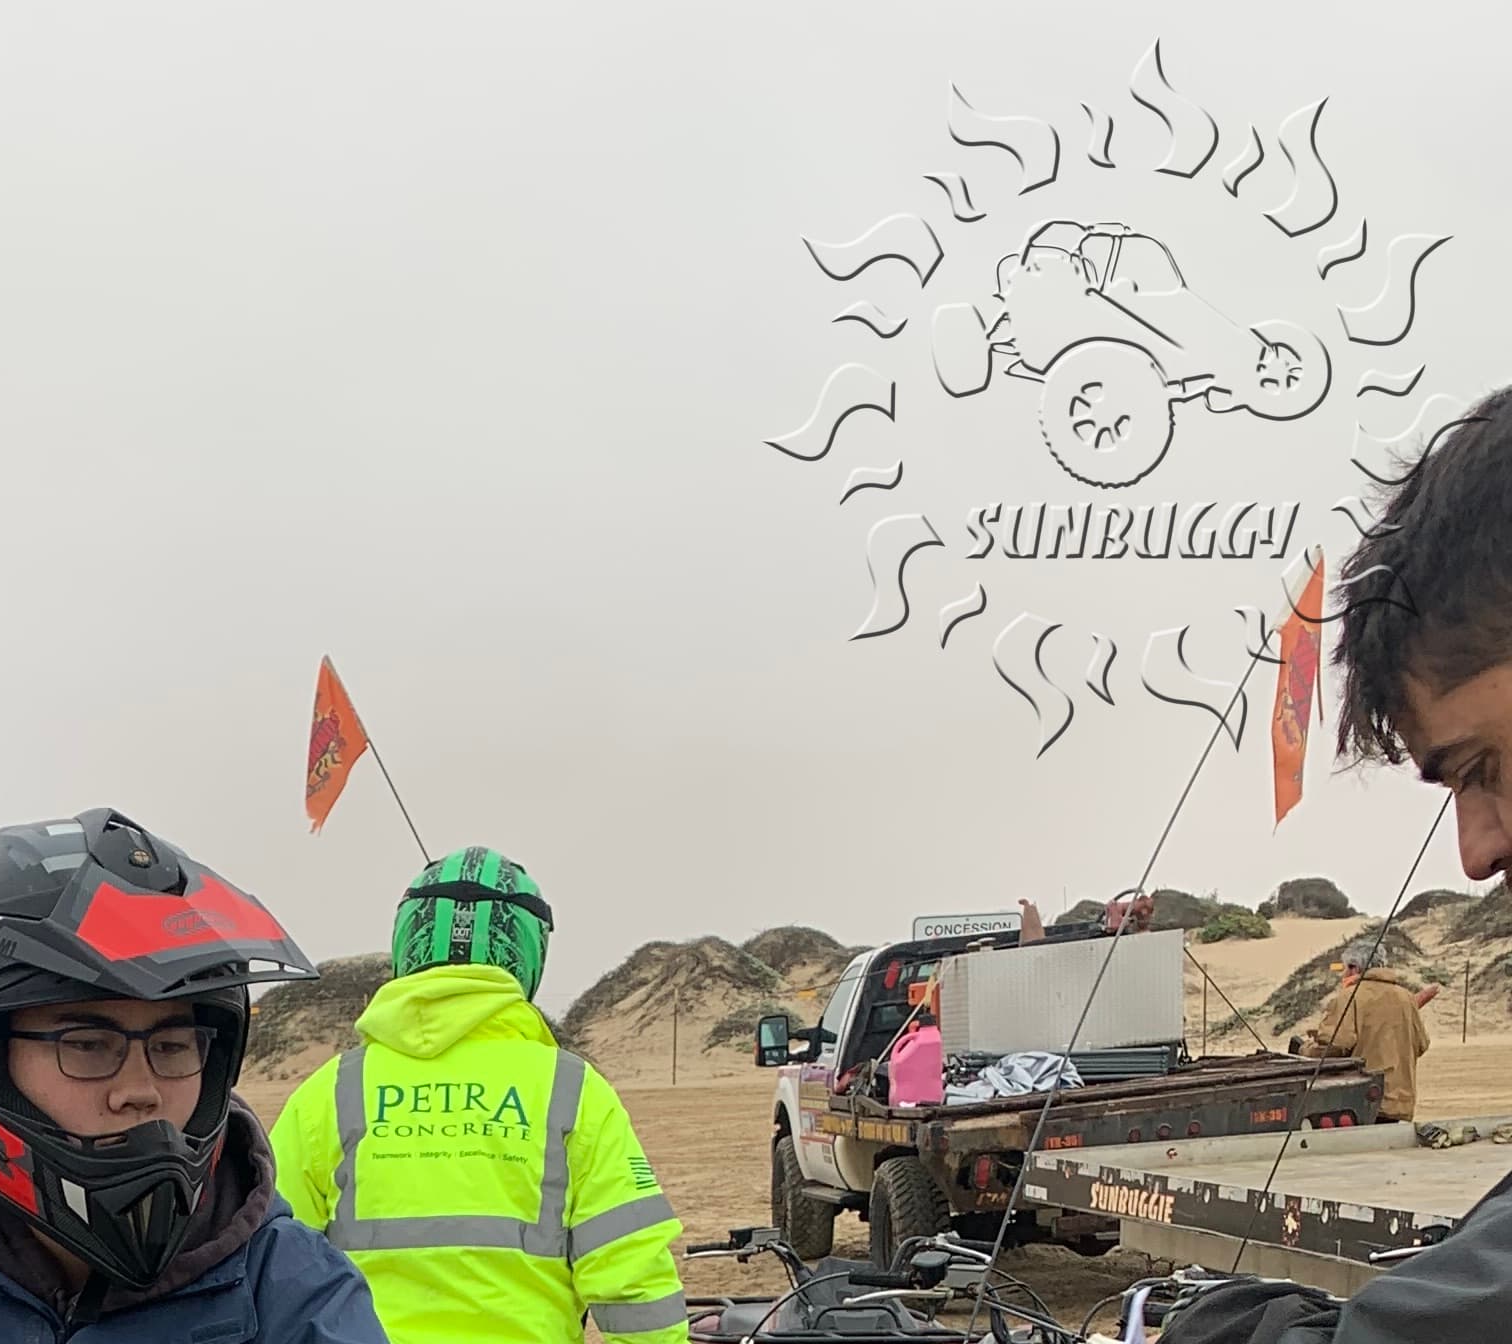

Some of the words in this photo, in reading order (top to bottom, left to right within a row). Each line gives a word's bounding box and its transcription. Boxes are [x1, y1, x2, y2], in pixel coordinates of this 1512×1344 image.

[371, 1082, 532, 1128] PETRA
[372, 1122, 531, 1142] CONCRETE
[419, 1151, 452, 1160] Integrity
[502, 1153, 529, 1165] Safety
